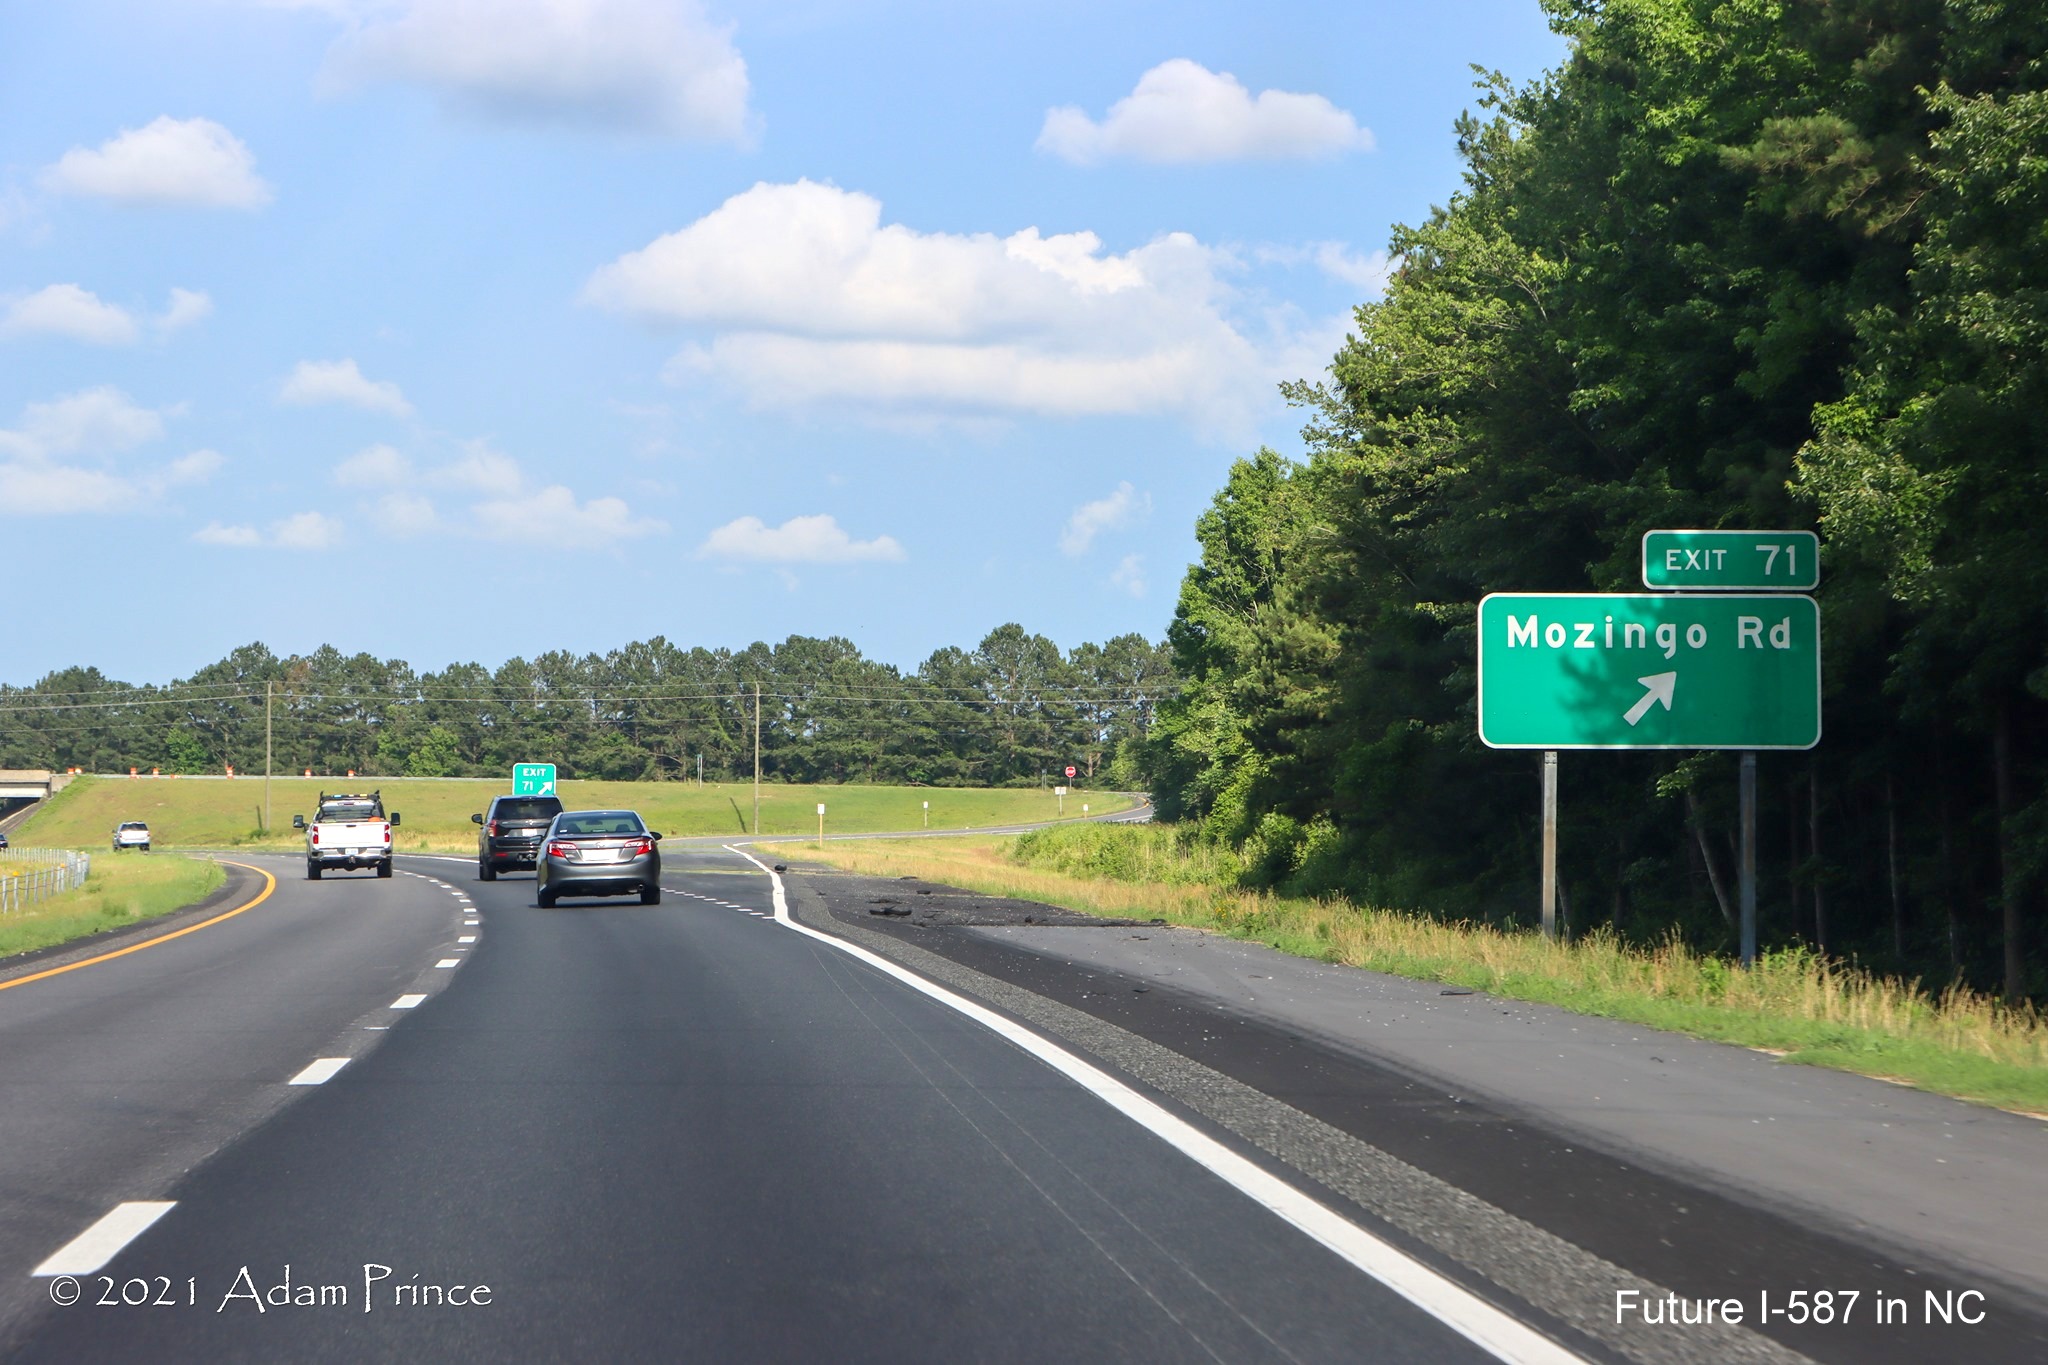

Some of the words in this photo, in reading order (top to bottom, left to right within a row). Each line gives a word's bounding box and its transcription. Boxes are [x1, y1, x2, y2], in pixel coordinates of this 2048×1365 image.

[1666, 549, 1727, 571] EXIT
[1755, 544, 1796, 575] 71
[1507, 614, 1707, 660] Mozingo
[1737, 615, 1791, 649] Rd
[522, 768, 546, 776] EXIT
[522, 781, 533, 791] 71
